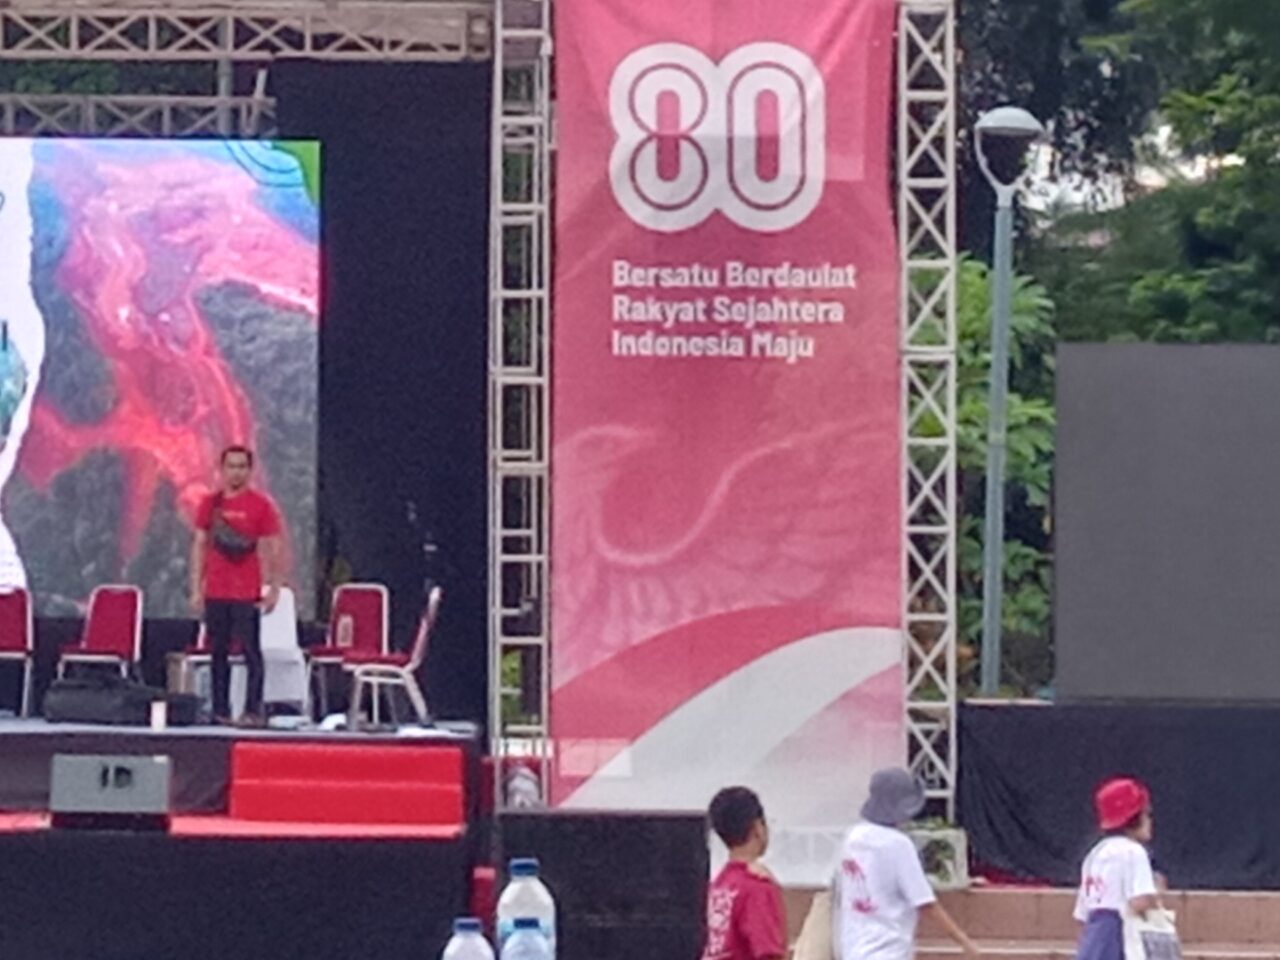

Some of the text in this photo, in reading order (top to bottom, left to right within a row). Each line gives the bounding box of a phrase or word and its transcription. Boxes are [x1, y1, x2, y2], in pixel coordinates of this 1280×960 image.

[609, 42, 826, 232] 80
[612, 260, 857, 289] Bersatu Berdaulat
[612, 295, 845, 328] Rakyat Sejahtera
[612, 330, 815, 364] Indonesia Maju
